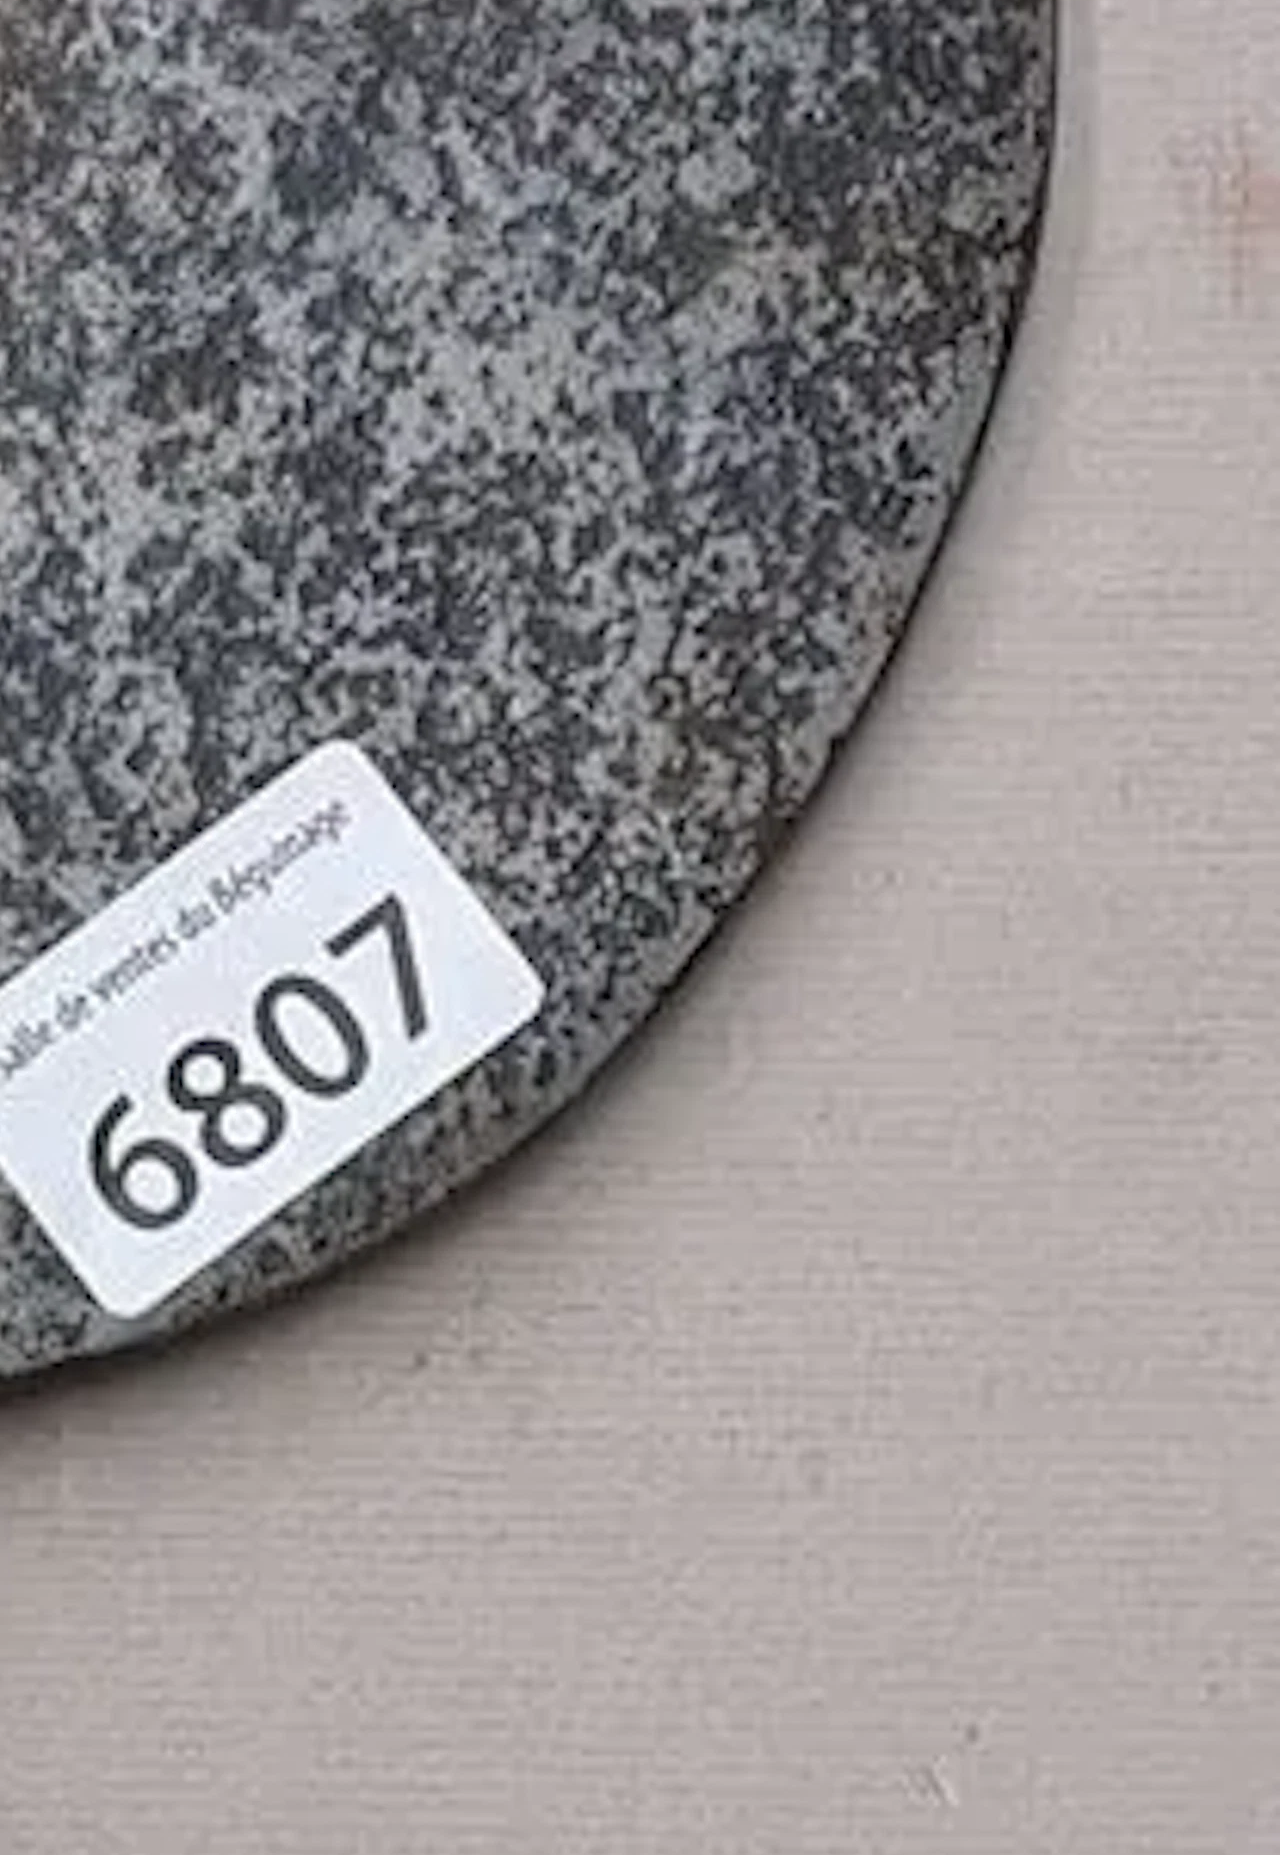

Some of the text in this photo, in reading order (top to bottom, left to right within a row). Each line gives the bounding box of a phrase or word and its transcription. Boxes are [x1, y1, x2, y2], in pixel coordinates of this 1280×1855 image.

[54, 993, 94, 1033] de
[88, 930, 179, 1004] ventes
[176, 902, 217, 940] du
[87, 889, 432, 1233] 6807
